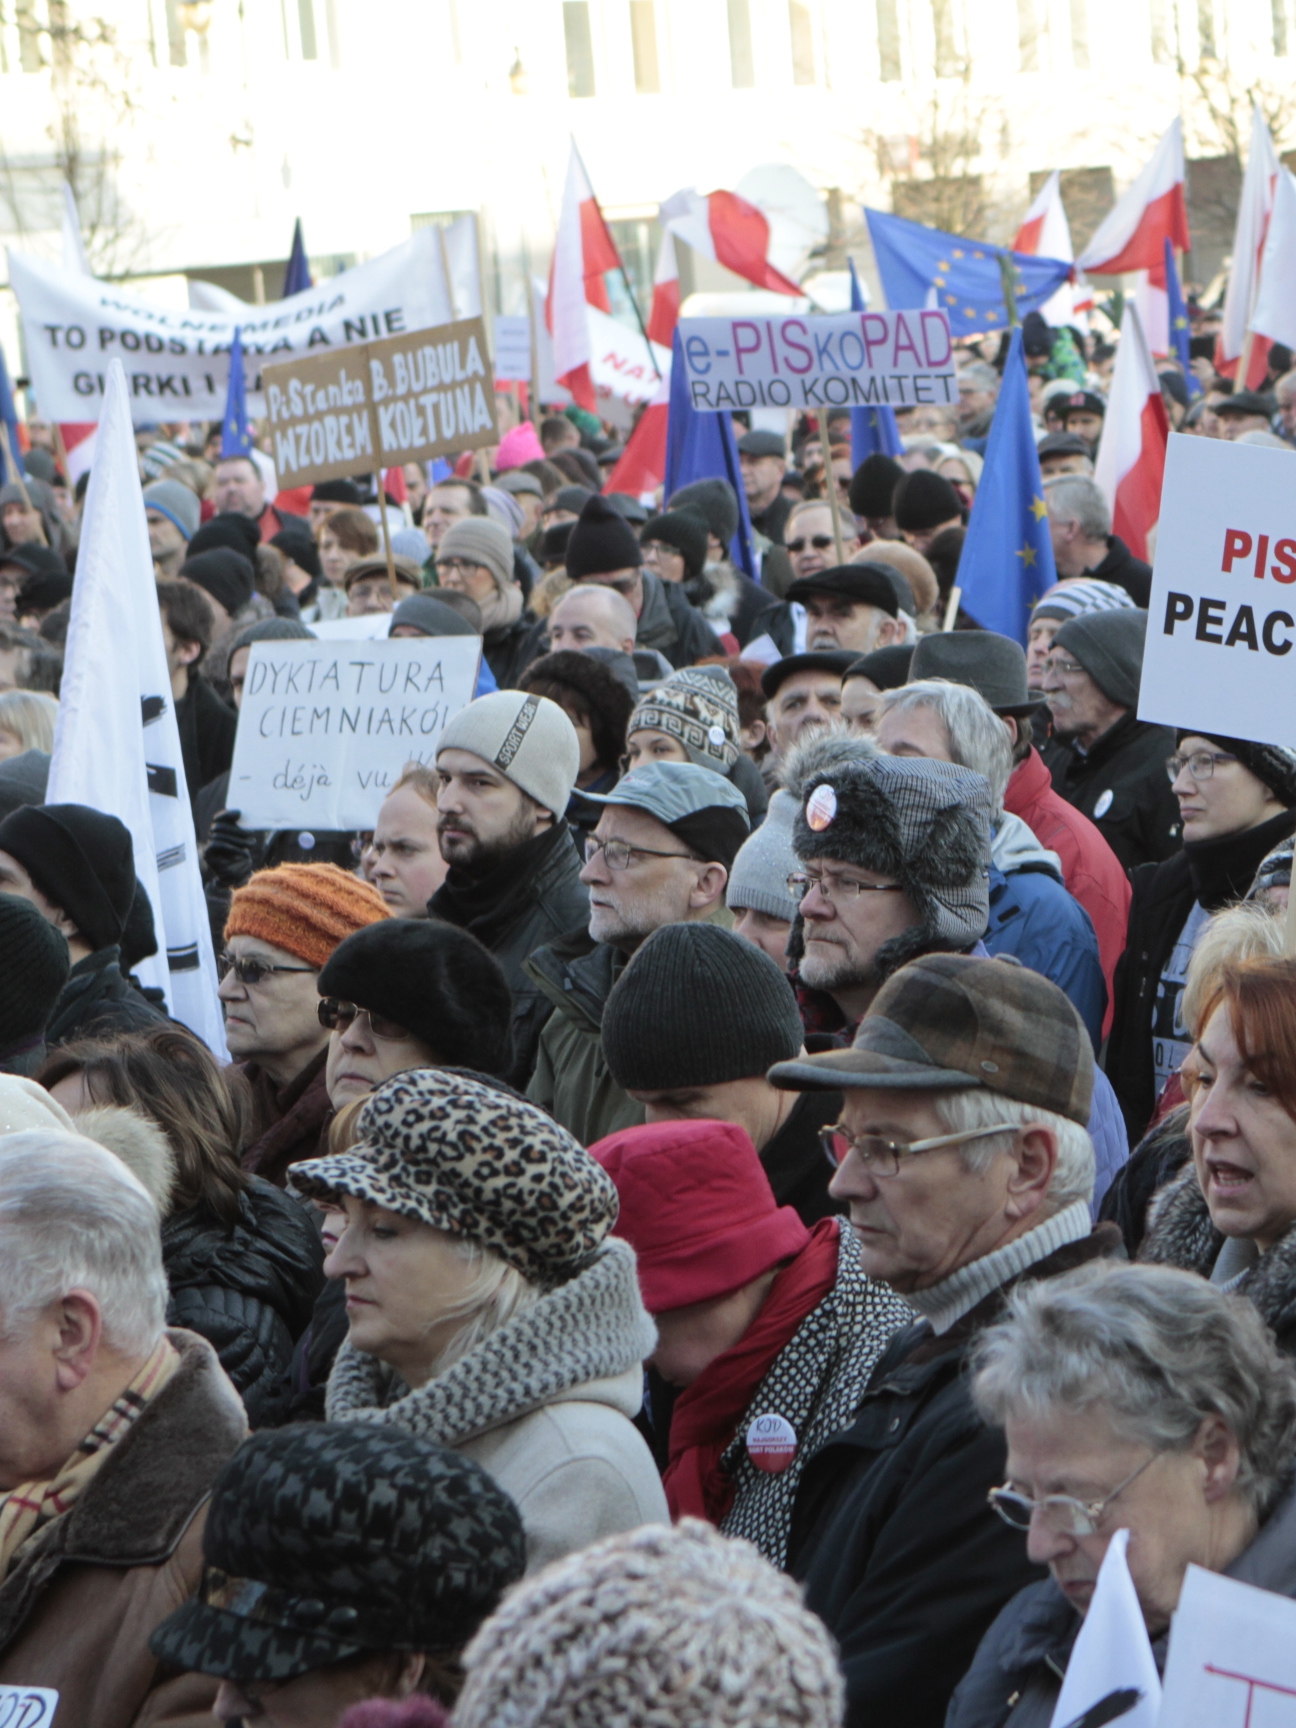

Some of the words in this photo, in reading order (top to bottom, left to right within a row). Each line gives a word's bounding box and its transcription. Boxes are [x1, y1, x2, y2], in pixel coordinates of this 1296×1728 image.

[44, 324, 86, 350] TO
[306, 319, 330, 347] A
[343, 308, 408, 343] NIE
[100, 296, 229, 334] WOLNE
[242, 293, 346, 333] MEDIA
[73, 371, 191, 397] GIRKI
[204, 372, 216, 396] I
[691, 378, 792, 409] RADIO
[801, 373, 956, 406] KOMITET
[274, 409, 373, 476] WZOREM
[378, 381, 494, 452] KOŁTUNA
[249, 660, 445, 696] DYKTATURA
[499, 727, 523, 765] SPORT
[272, 759, 332, 801] déjà
[357, 770, 391, 790] vu
[756, 1418, 782, 1433] KOD
